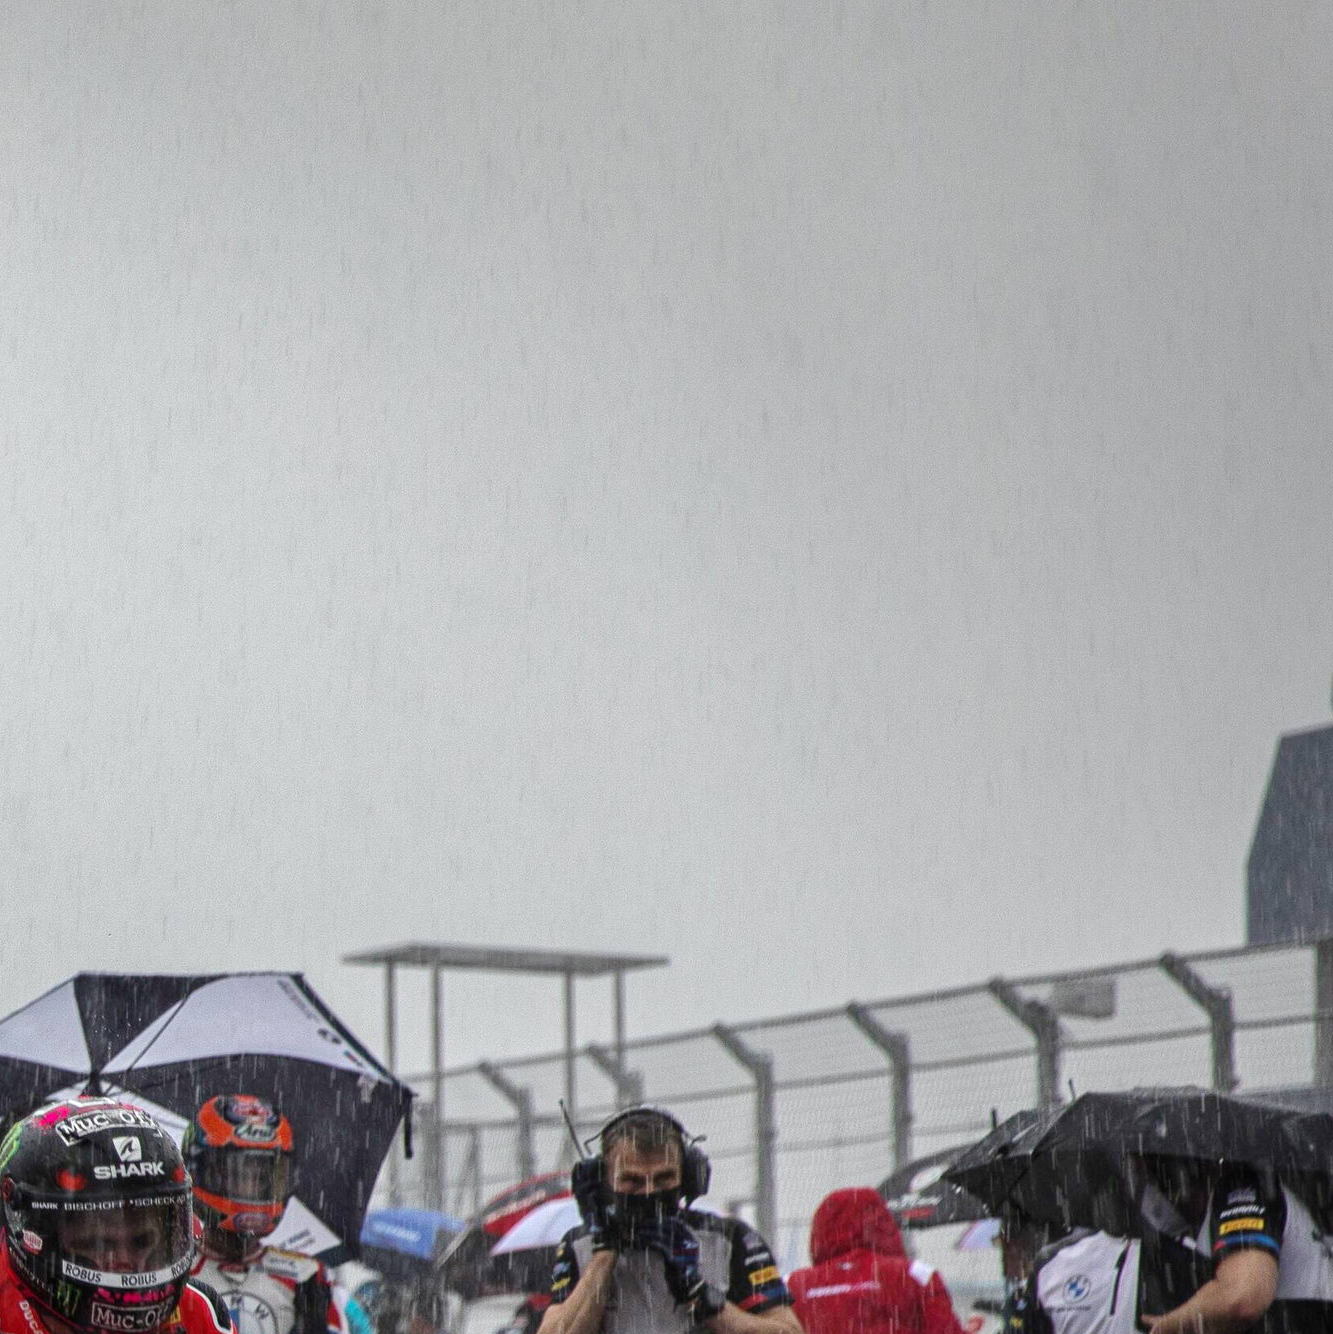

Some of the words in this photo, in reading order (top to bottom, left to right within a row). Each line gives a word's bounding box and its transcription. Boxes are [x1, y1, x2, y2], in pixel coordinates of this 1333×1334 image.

[94, 1161, 165, 1180] SHARK
[32, 1202, 58, 1210] SHARK
[64, 1200, 123, 1211] BISCHOFF
[65, 1263, 102, 1283] ROBUS
[121, 1273, 157, 1287] ROBUS
